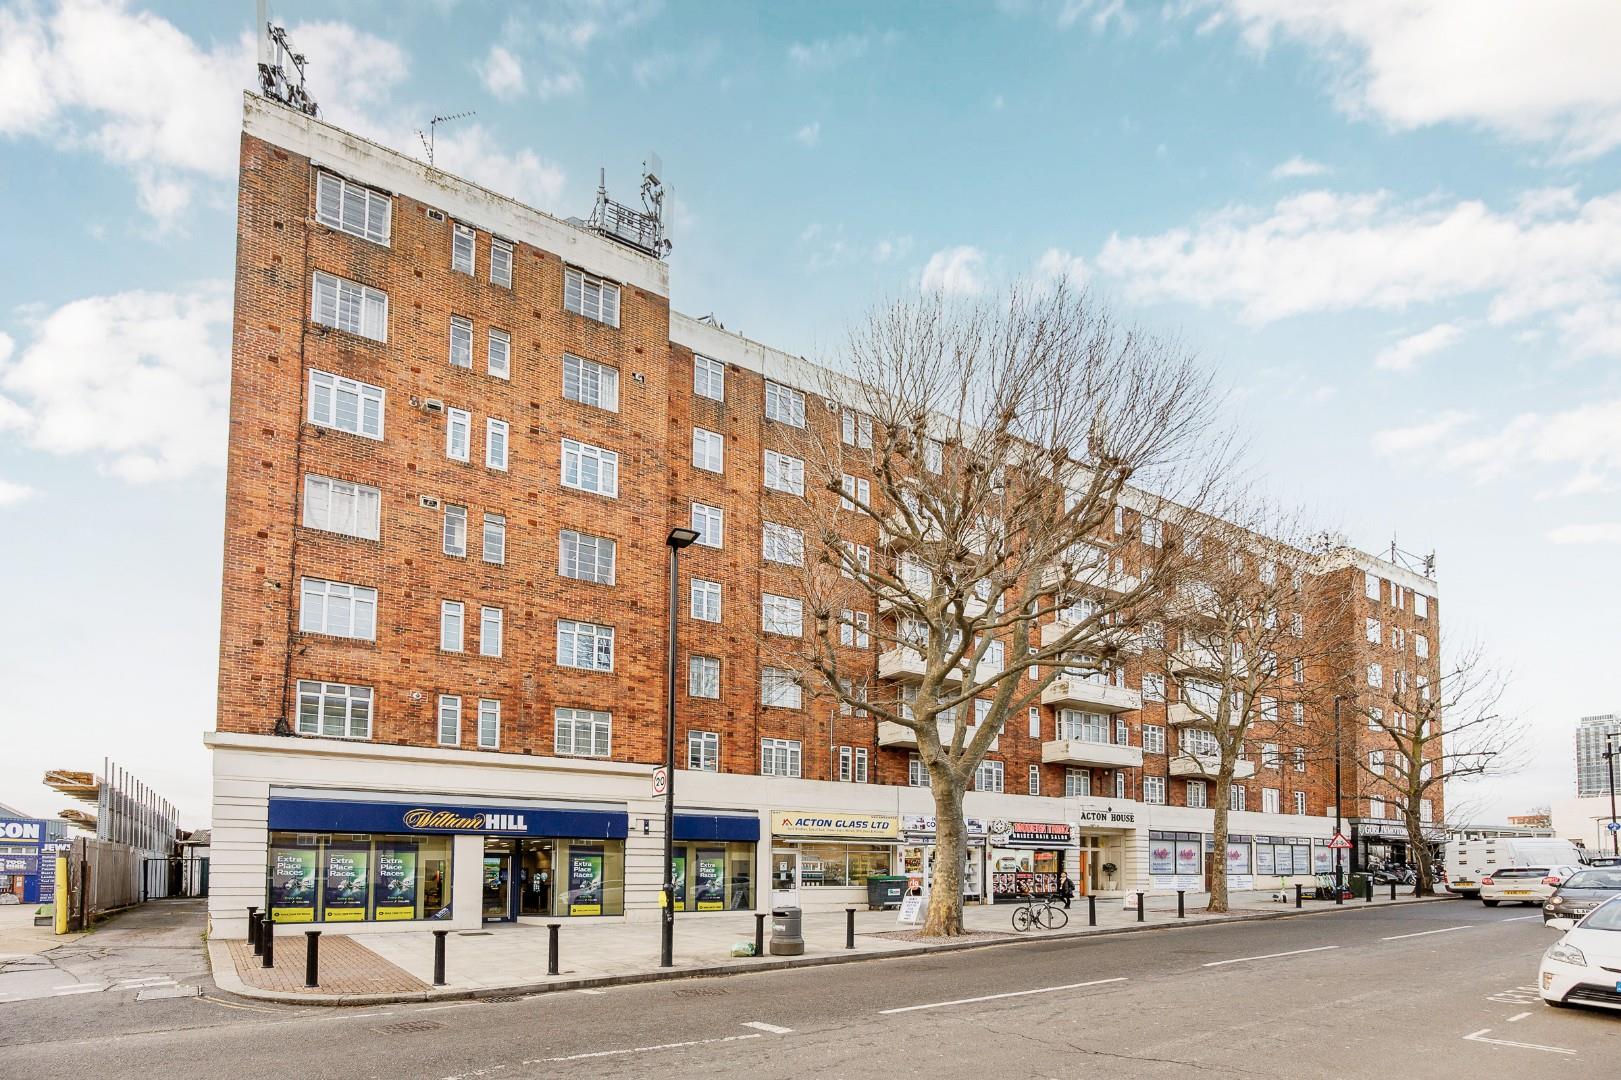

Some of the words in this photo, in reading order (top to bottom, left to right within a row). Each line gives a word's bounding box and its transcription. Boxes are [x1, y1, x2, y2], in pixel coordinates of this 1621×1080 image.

[656, 777, 665, 786] 20
[403, 809, 486, 830] William
[485, 814, 528, 830] HILL
[1080, 812, 1107, 821] ACTON
[1111, 814, 1135, 823] HOUSE
[795, 818, 832, 828] ACTON
[835, 820, 869, 829] GLASS
[871, 821, 890, 830] LTD
